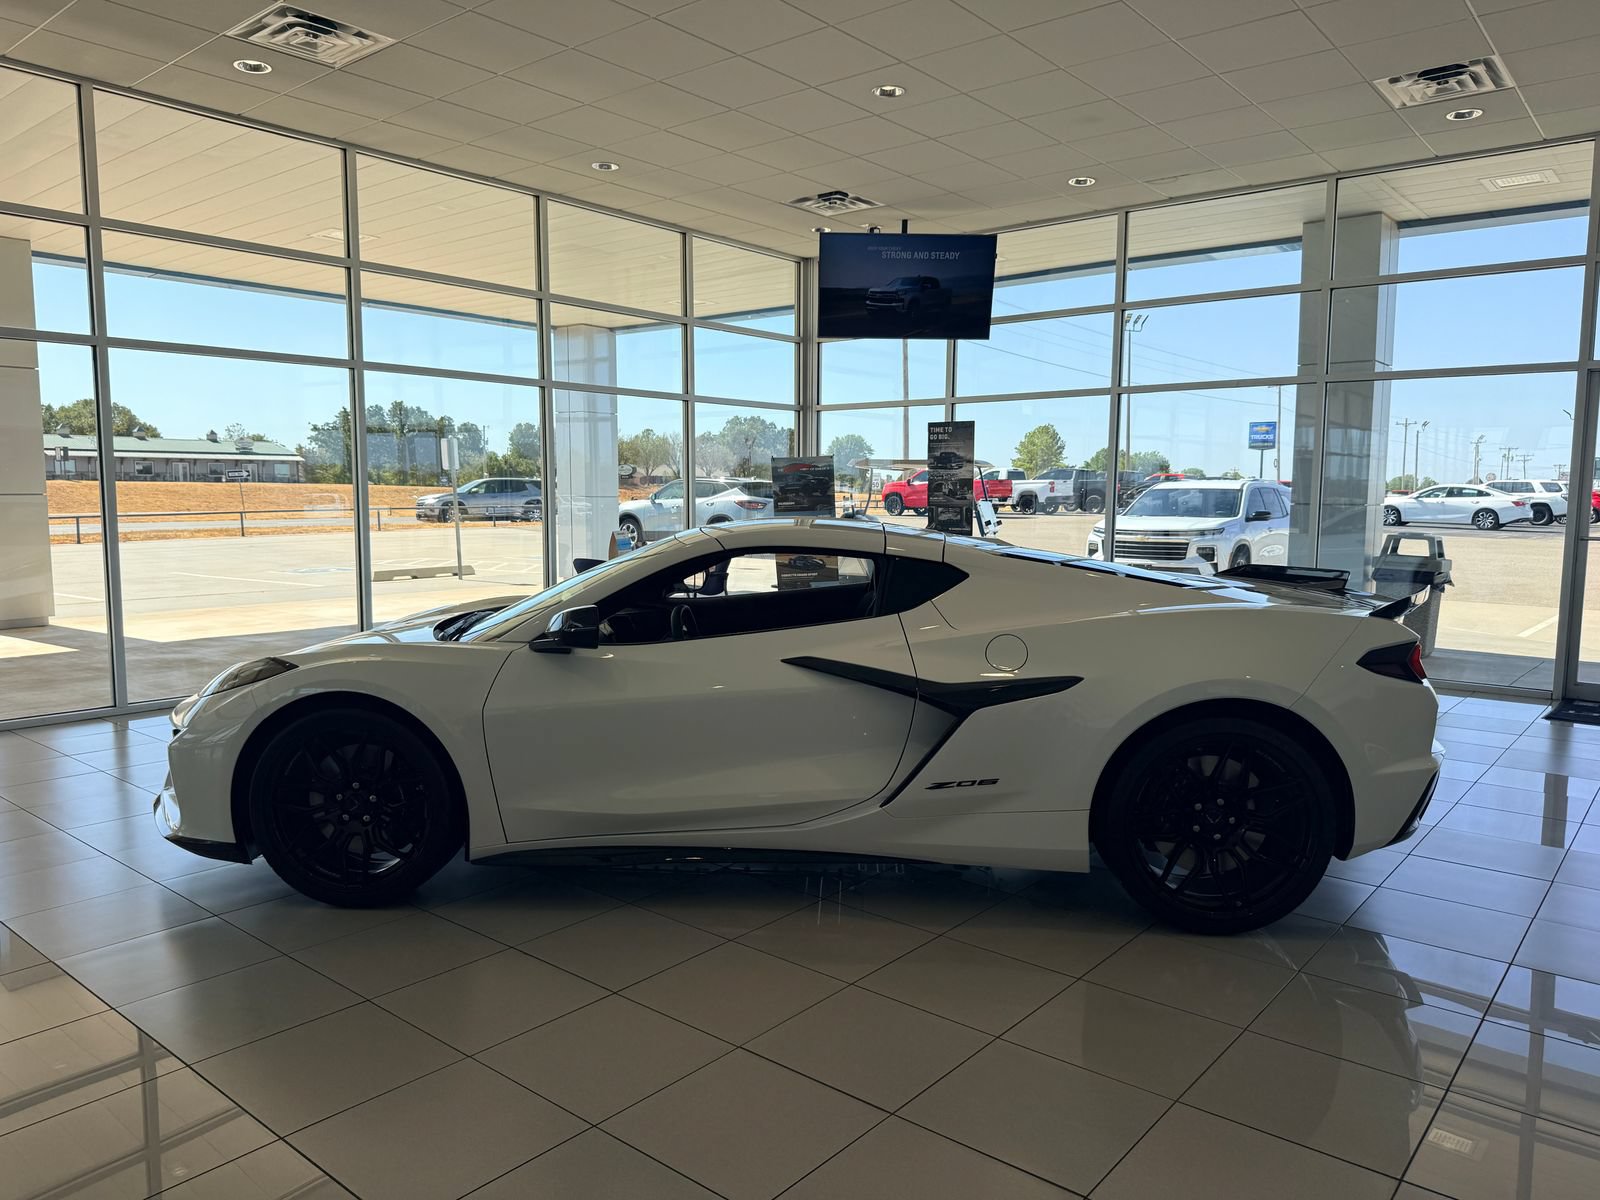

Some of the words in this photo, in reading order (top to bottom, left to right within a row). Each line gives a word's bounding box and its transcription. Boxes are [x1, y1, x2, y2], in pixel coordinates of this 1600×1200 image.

[881, 251, 912, 259] STRONG
[913, 251, 929, 260] AND
[931, 251, 960, 260] STEADY
[924, 778, 1000, 790] Z06
